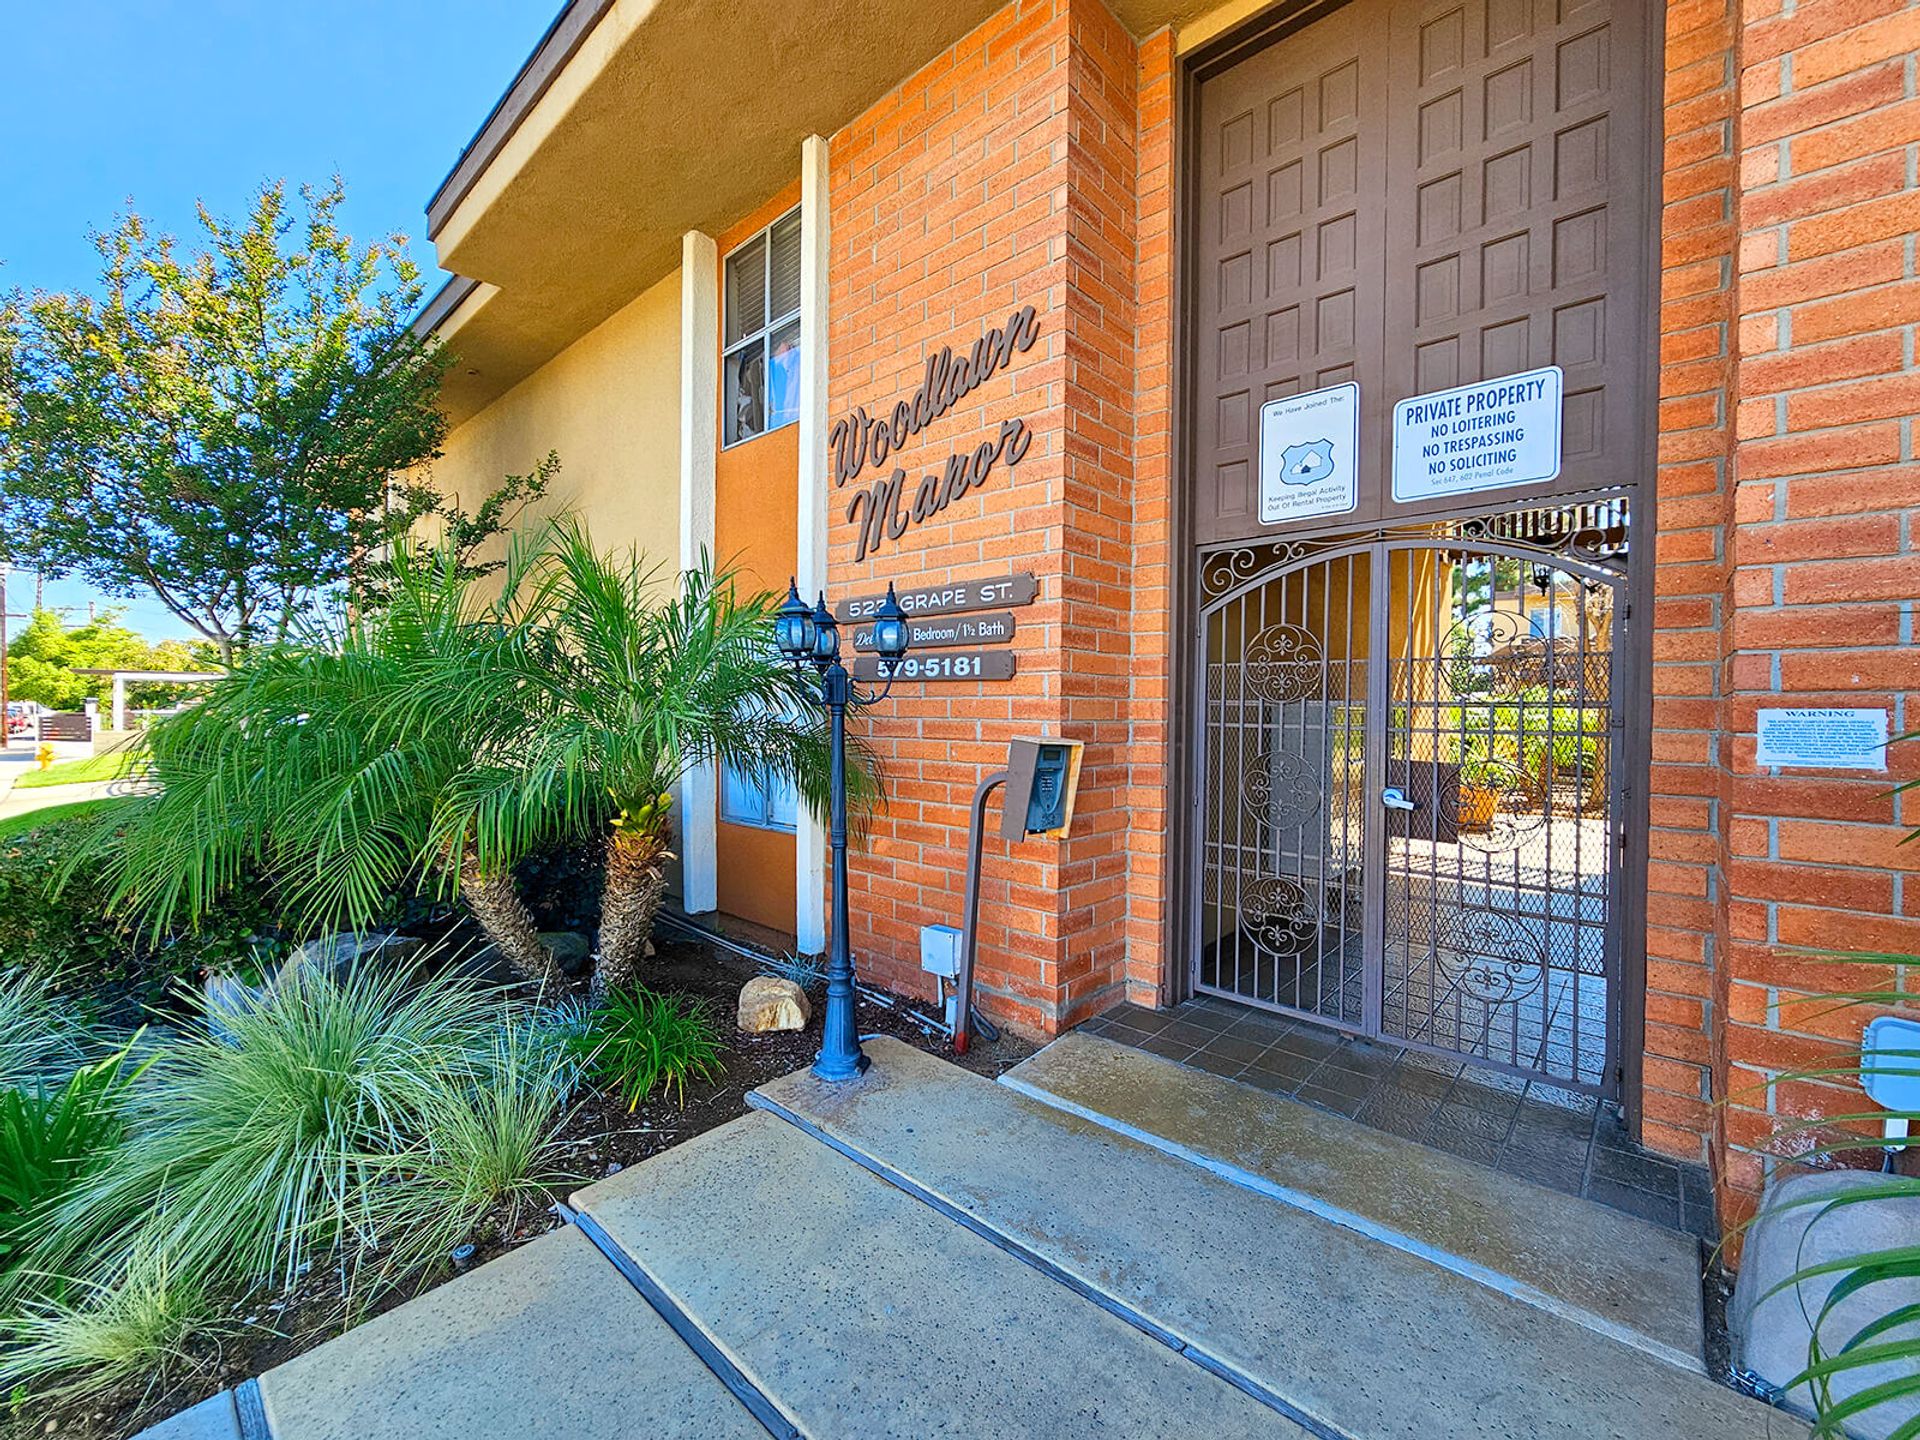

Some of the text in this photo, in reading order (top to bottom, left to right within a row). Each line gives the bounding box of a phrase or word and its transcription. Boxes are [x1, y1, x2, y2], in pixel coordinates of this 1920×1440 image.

[830, 304, 1041, 488] Woodlawn
[1304, 399, 1328, 410] Joined
[1406, 378, 1546, 426] PRIVATE PROPERTY
[1431, 410, 1516, 438] NO LOITERING
[1422, 428, 1524, 458] NO TRESPASSING
[1428, 449, 1517, 475] NO SOLICITING
[1460, 472, 1473, 480] 602
[1474, 469, 1494, 479] Penal
[1496, 466, 1514, 476] Code
[846, 418, 1032, 562] Manor
[1268, 485, 1346, 503] Keeping Illegal Activity
[1292, 499, 1314, 507] Rental
[1316, 495, 1347, 504] Property
[899, 589, 966, 612] GRAPE
[980, 582, 1013, 602] ST.
[978, 620, 1004, 636] Bath
[1785, 710, 1855, 718] WARNING
